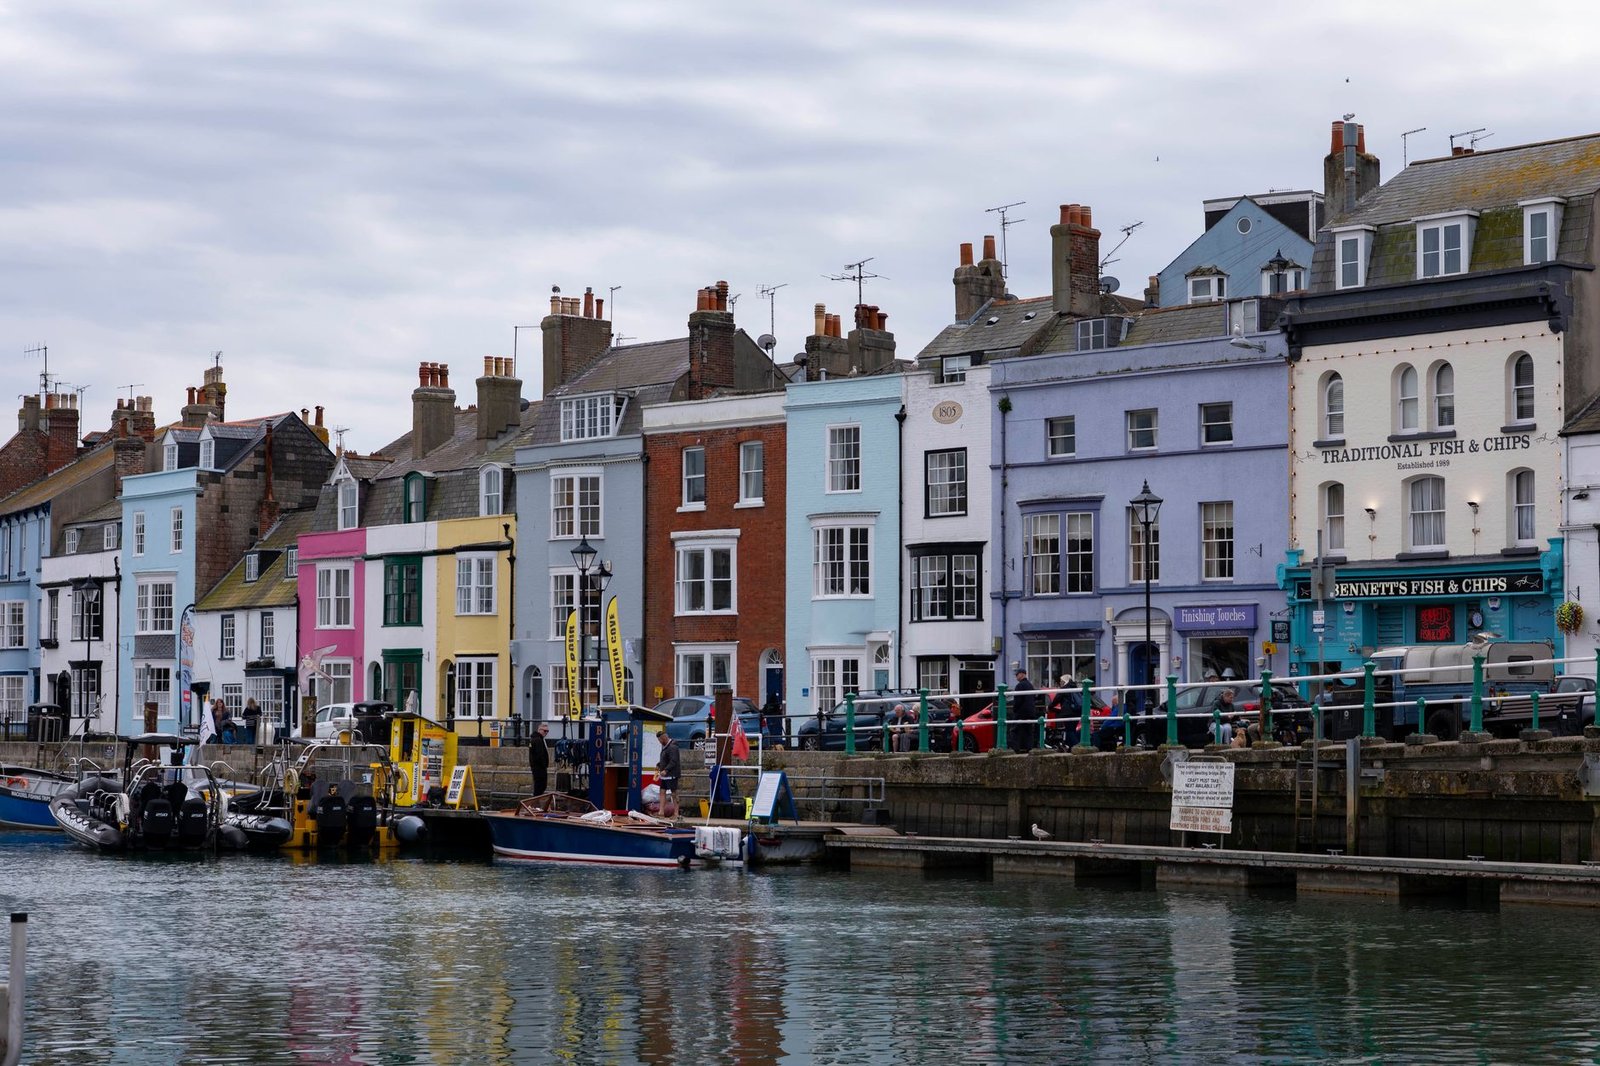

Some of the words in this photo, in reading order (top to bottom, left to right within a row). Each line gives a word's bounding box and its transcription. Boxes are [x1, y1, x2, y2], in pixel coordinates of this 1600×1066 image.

[939, 406, 957, 418] 1805
[1322, 443, 1422, 464] TRADITIONAL
[1429, 440, 1464, 456] FISH
[1468, 440, 1480, 453] &
[1483, 434, 1531, 452] CHIPS
[1397, 460, 1435, 470] Established
[1436, 459, 1450, 468] 1989
[1334, 581, 1408, 597] BENNETT'S
[1410, 580, 1444, 595] FISH
[1448, 580, 1459, 593] &
[1462, 576, 1508, 593] CHIPS
[1181, 608, 1216, 625] Finishing
[1216, 607, 1246, 622] Touches
[608, 613, 617, 644] COVE
[595, 725, 603, 775] BOAT
